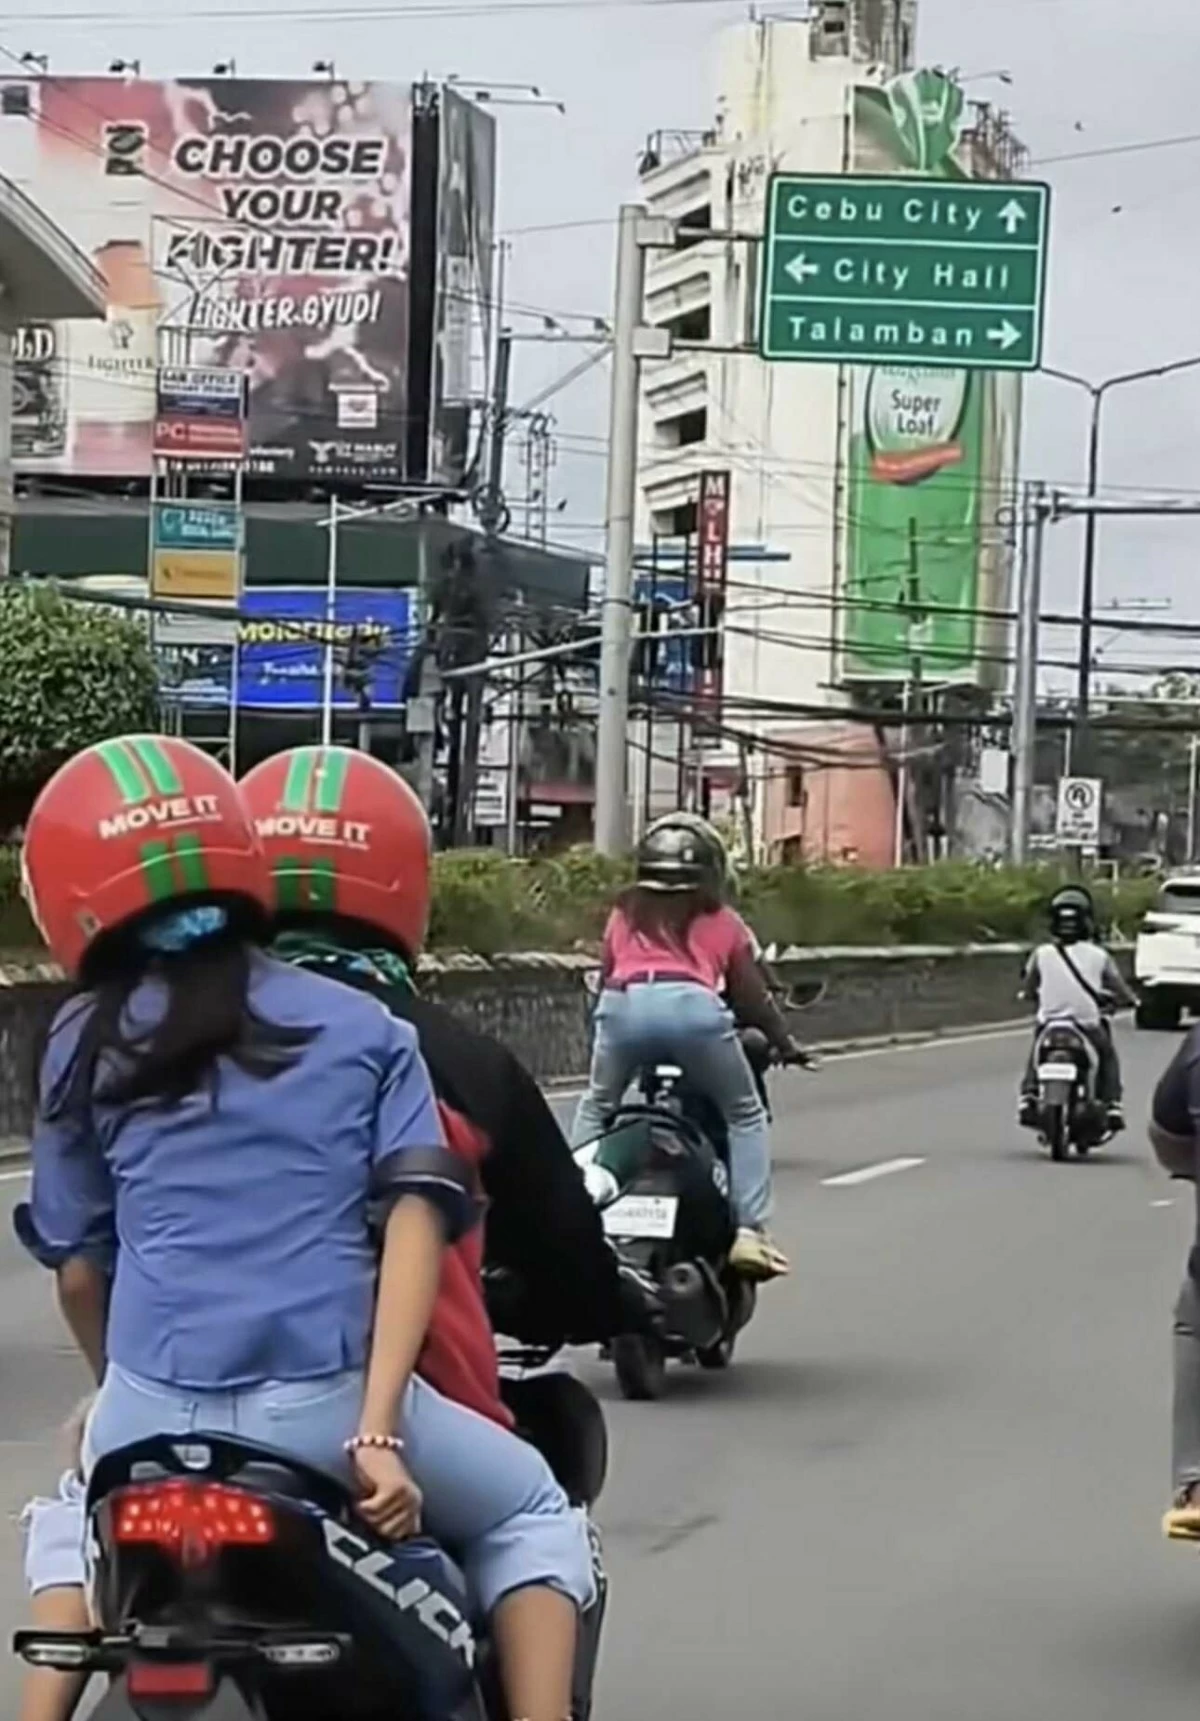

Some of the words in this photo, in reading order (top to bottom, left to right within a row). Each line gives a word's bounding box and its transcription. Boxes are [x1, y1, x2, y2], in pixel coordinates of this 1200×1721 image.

[175, 139, 383, 174] CHOOSE
[223, 188, 342, 222] YOUR
[787, 194, 883, 221] Cebu
[903, 197, 982, 232] City
[166, 235, 394, 270] FIGHTER!
[833, 257, 909, 291] City
[933, 262, 1009, 290] Hall
[788, 316, 974, 347] Talamban
[891, 388, 942, 416] Super
[897, 412, 935, 436] Loaf
[99, 797, 191, 839] MOVE
[193, 795, 219, 814] IT
[255, 816, 337, 837] MOVE
[343, 820, 371, 842] IT
